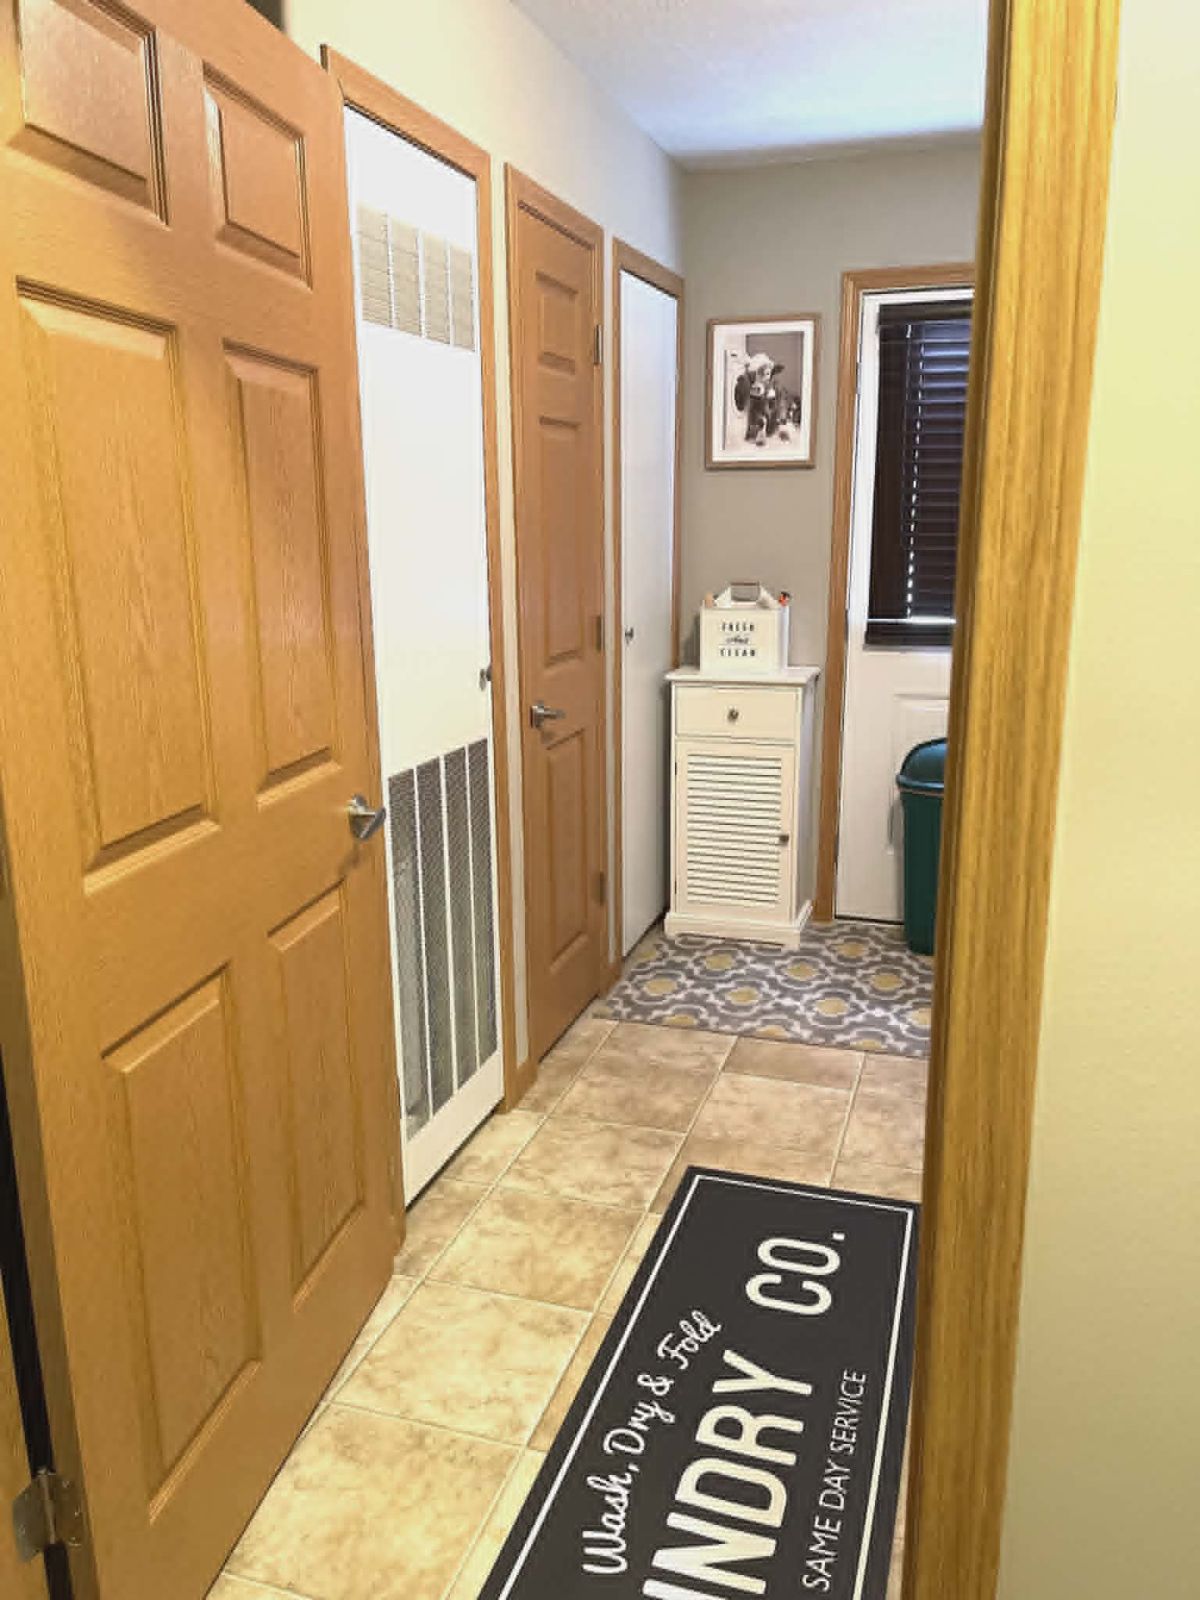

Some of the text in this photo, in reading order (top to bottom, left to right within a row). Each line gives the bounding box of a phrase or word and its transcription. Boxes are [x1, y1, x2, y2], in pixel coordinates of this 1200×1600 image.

[581, 1310, 722, 1574] Wash, Dry & Fold
[642, 1233, 845, 1600] NDRY CO.
[801, 1369, 867, 1593] SAME DAY SERVICE
